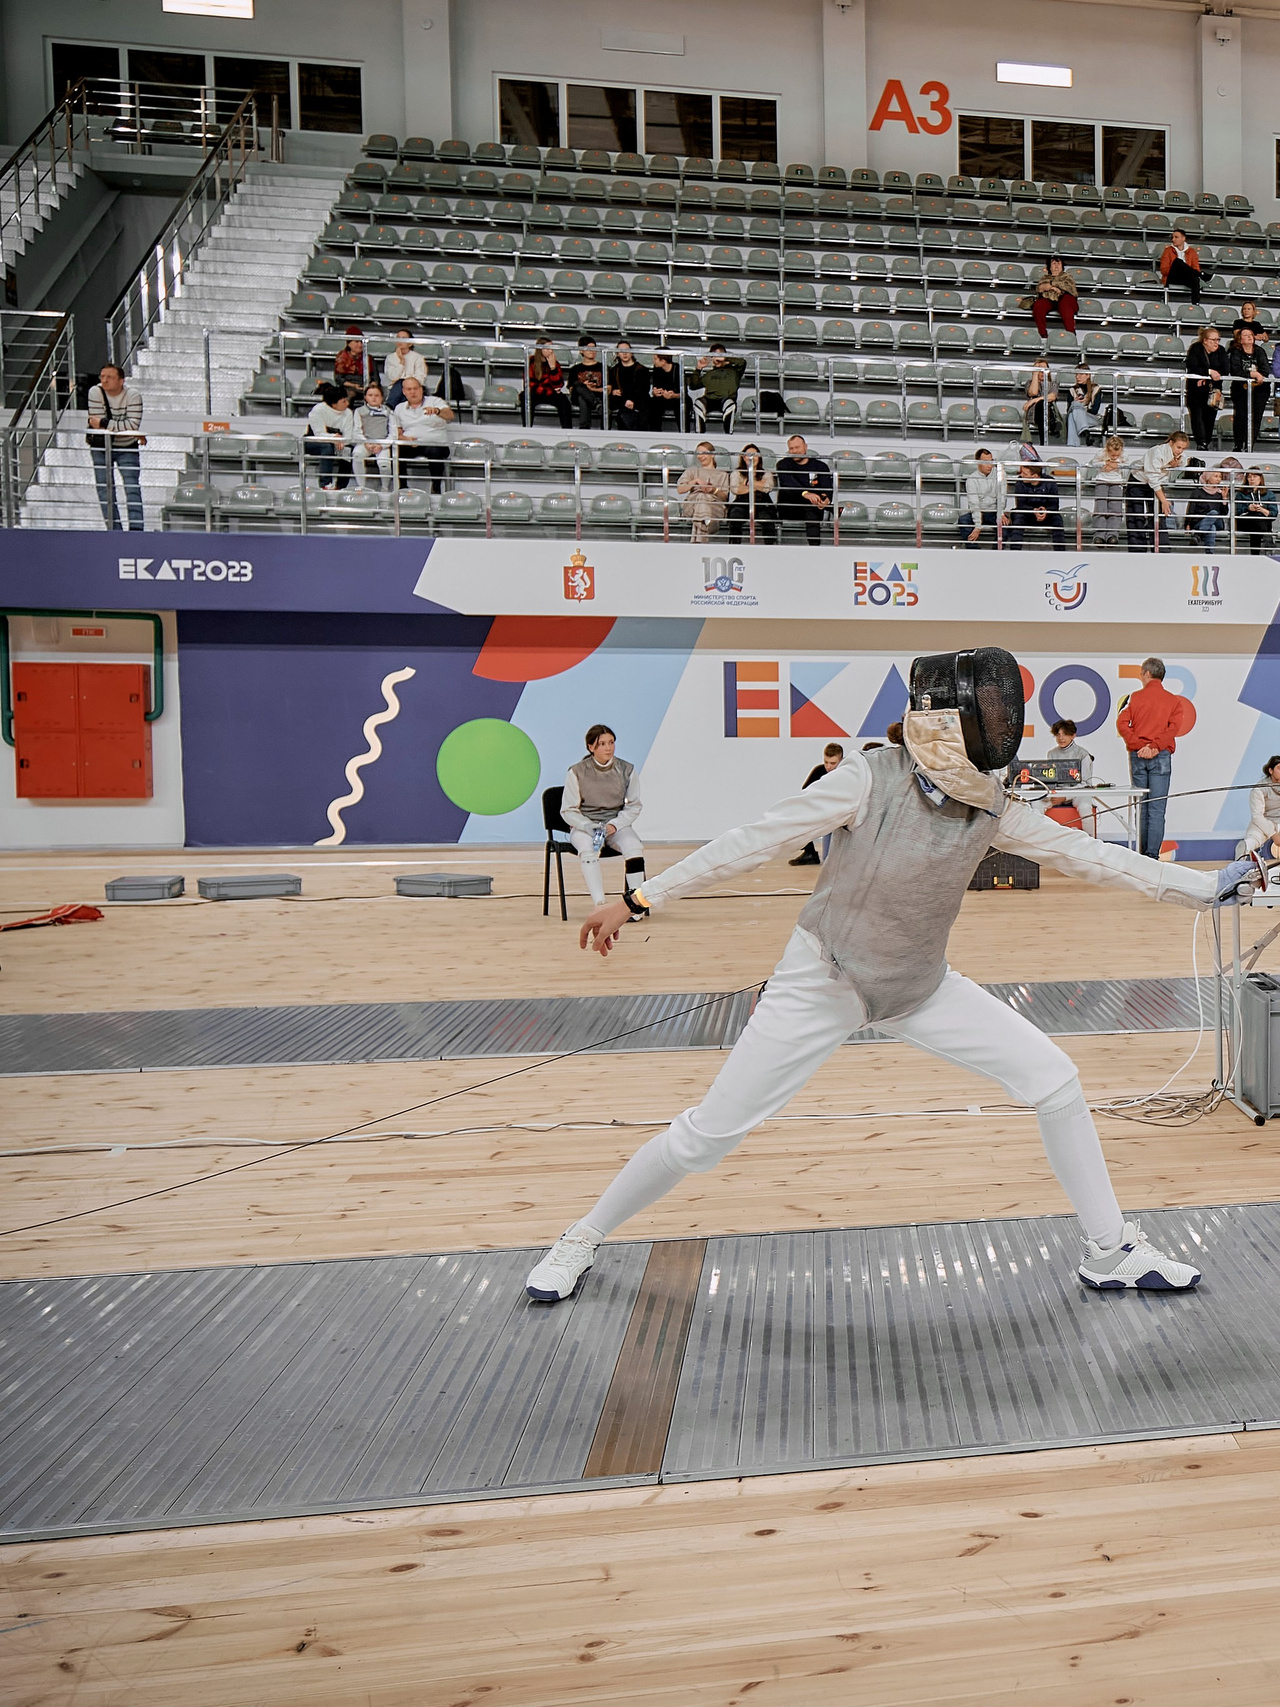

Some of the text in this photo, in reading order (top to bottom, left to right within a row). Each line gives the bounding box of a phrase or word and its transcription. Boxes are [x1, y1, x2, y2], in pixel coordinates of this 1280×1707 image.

[868, 79, 953, 135] A3
[118, 558, 253, 582] EKAT2023
[854, 562, 918, 581] EKAT
[854, 582, 918, 606] 2023
